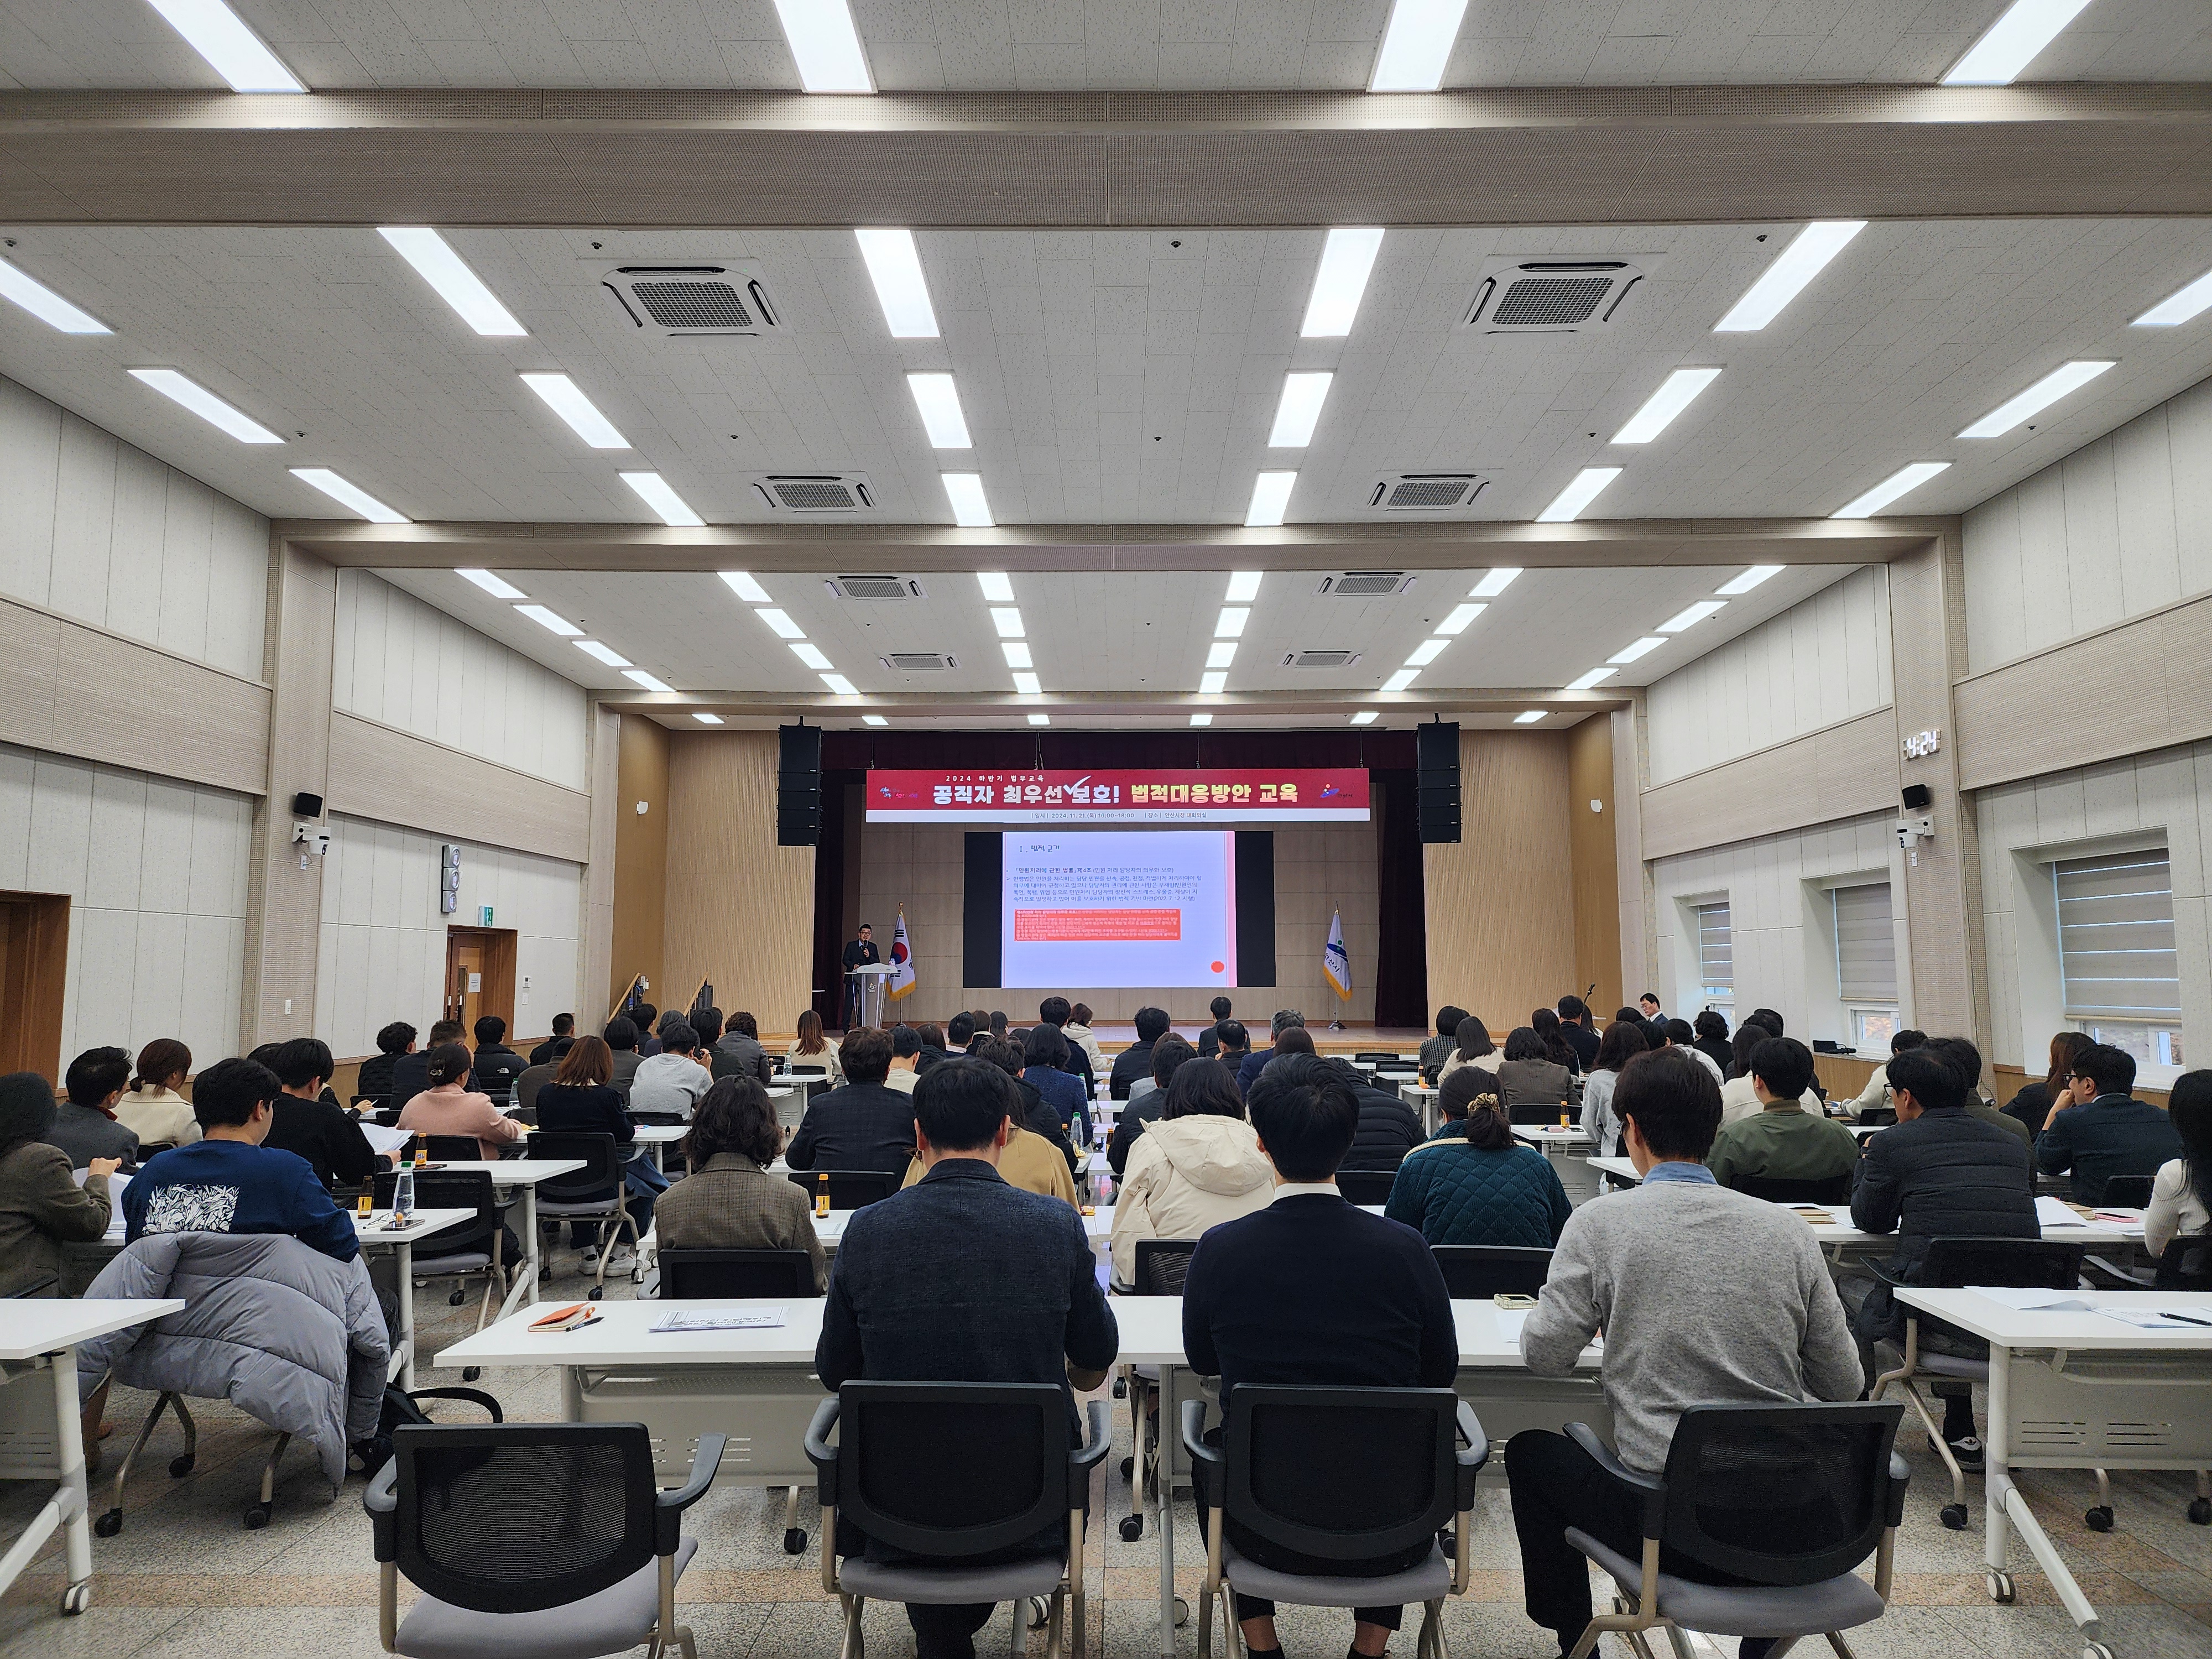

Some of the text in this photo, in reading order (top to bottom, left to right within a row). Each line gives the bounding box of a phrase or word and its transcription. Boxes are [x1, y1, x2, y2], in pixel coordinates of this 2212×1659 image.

[1906, 730, 1937, 757] 4:24
[933, 785, 994, 805] 공직자
[1003, 785, 1062, 804] 최우선
[1072, 785, 1119, 804] 보호!
[1131, 784, 1251, 804] 법적대응방안
[1259, 784, 1298, 802] 교육
[1031, 844, 1045, 853] 법적
[1047, 844, 1060, 853] 근거
